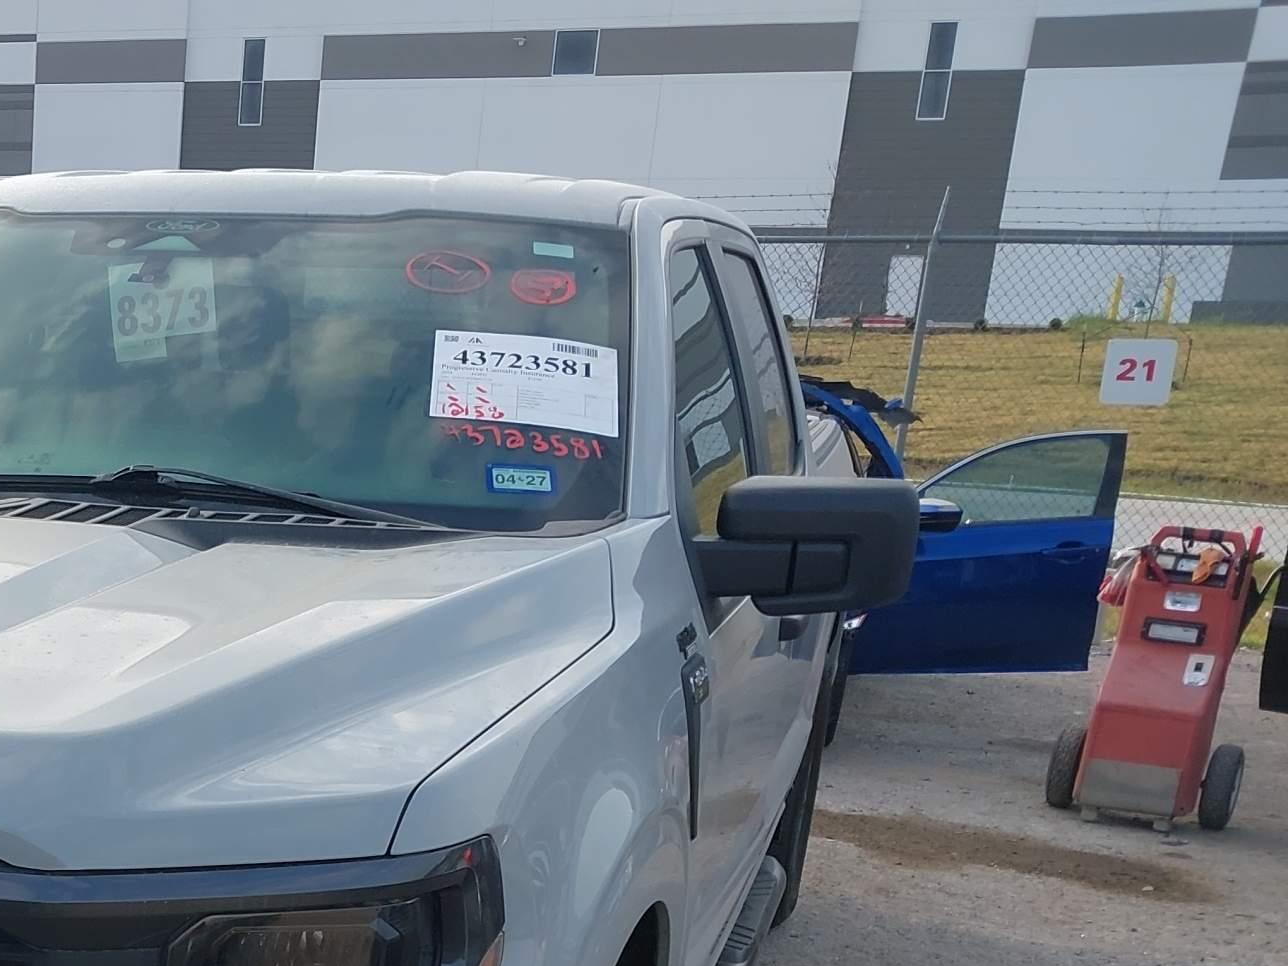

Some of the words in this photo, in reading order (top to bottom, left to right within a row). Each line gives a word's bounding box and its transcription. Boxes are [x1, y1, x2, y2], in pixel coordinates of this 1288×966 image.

[117, 286, 209, 337] 8373
[453, 350, 593, 378] 43723581
[1115, 358, 1157, 382] 21
